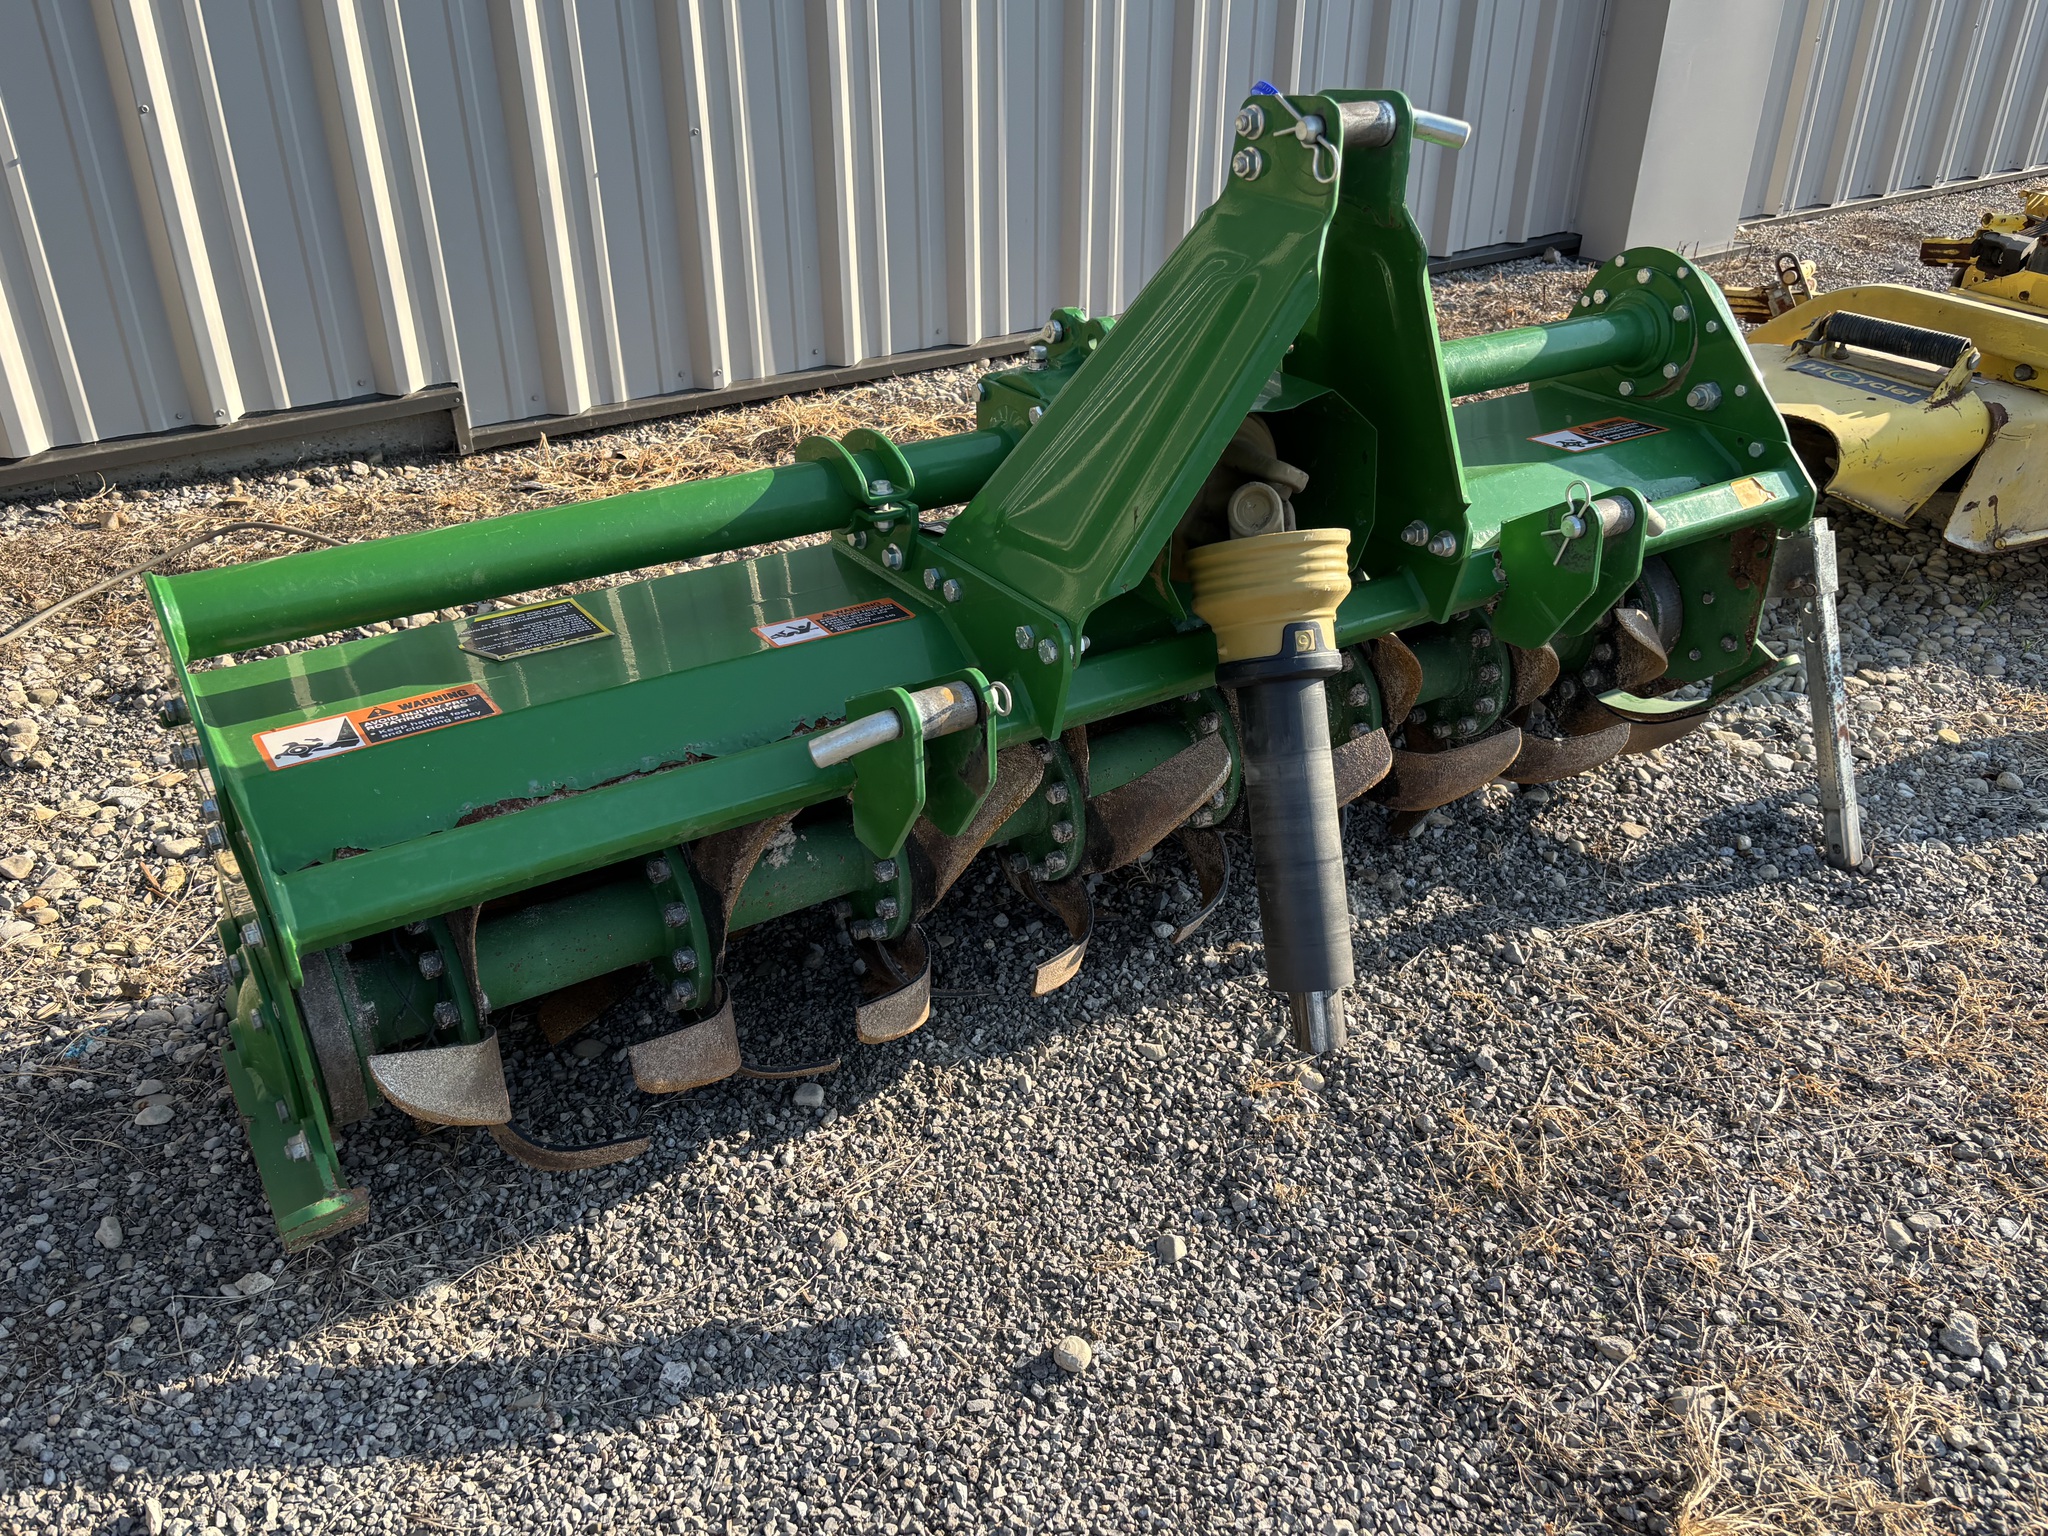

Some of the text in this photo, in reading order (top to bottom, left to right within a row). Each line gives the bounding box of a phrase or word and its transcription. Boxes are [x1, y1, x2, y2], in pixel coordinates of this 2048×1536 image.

[364, 695, 478, 728] AVOID INJURY FROM
[397, 689, 469, 711] WARNING
[366, 703, 469, 731] ROTATING KNIVES
[378, 708, 472, 735] Keep hands, feet
[381, 710, 481, 738] and clothing away
